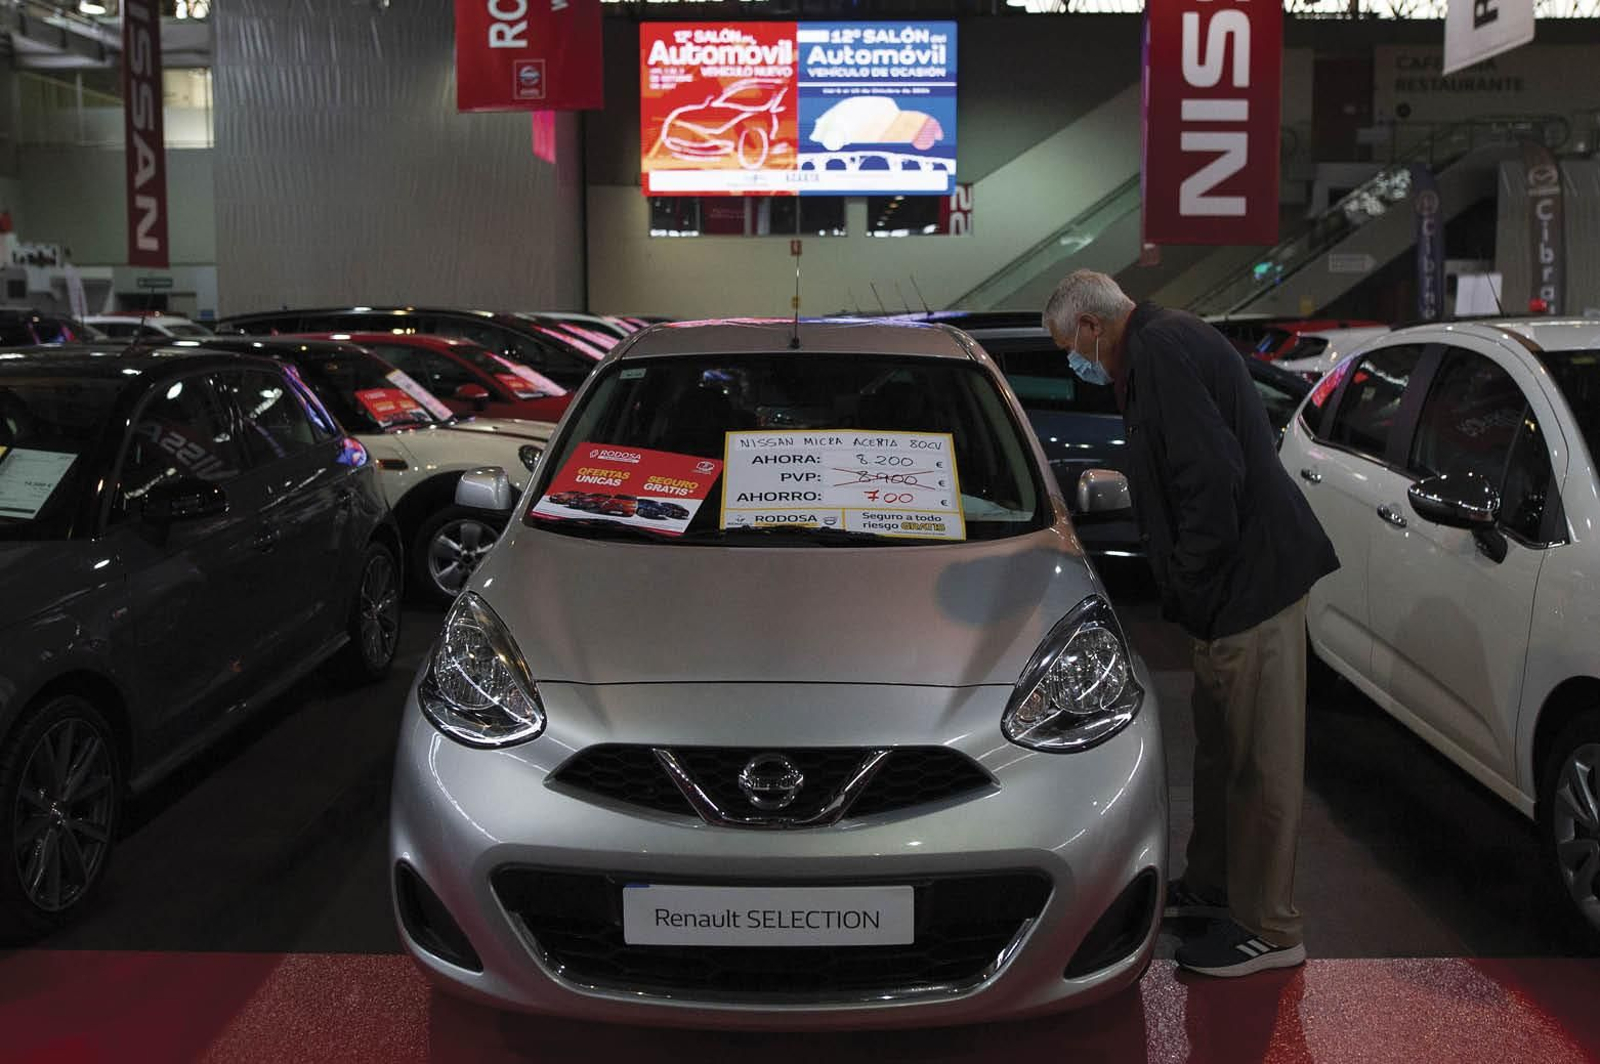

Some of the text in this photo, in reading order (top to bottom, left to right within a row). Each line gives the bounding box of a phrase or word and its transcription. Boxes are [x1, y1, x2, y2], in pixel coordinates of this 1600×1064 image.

[863, 26, 930, 44] SALÓN
[647, 39, 793, 65] Automóvil
[806, 44, 947, 65] Automóvil
[1180, 0, 1250, 216] NIS
[740, 437, 794, 449] NISSAN
[599, 450, 642, 460] RODOSA
[752, 455, 821, 465] AHORA:
[577, 467, 631, 480] OFERTAS
[780, 473, 822, 482] PVP:
[575, 475, 622, 487] UNICAS
[647, 475, 699, 490] SEGURO
[737, 492, 822, 502] AHORRO:
[864, 489, 914, 503] 700
[755, 513, 818, 523] RODOSA
[862, 512, 903, 522] Seguro
[915, 513, 942, 523] todo
[862, 521, 899, 531] riesgo
[654, 908, 880, 929] Renault SELECTION
